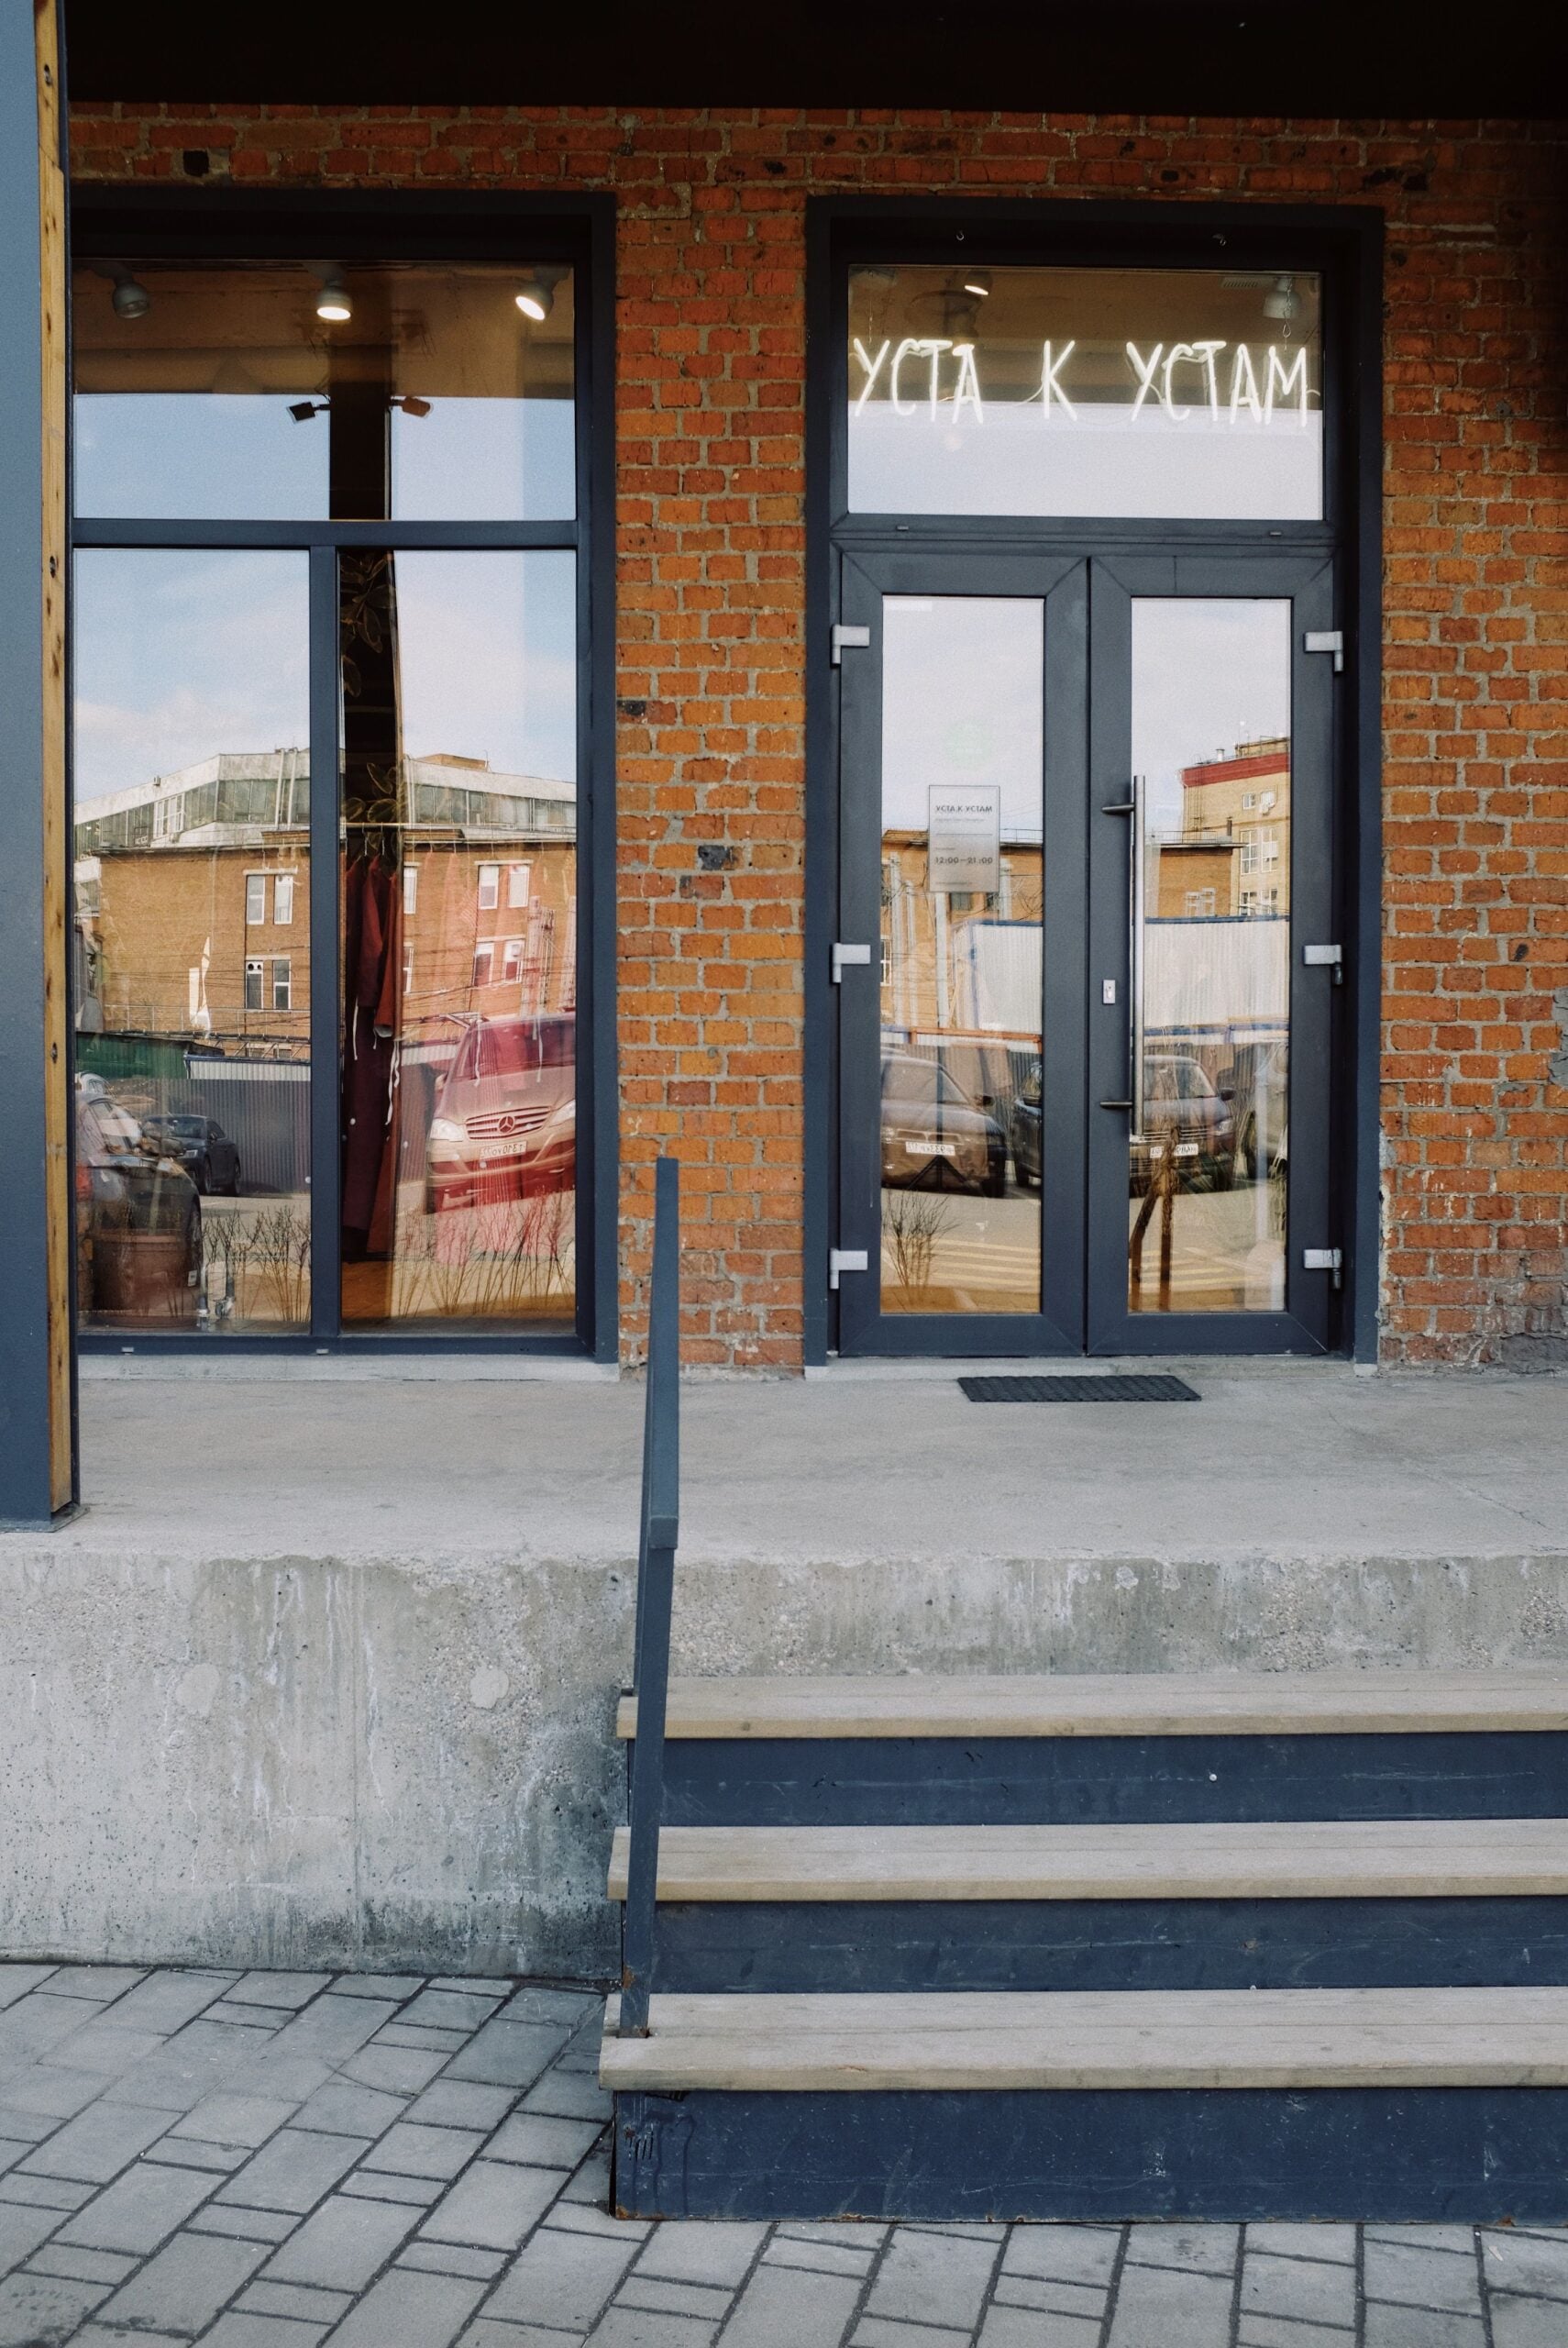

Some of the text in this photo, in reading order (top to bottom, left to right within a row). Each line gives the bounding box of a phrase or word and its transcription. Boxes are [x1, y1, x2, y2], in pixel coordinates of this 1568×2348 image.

[853, 337, 1309, 428] УСТА К УСТАМ
